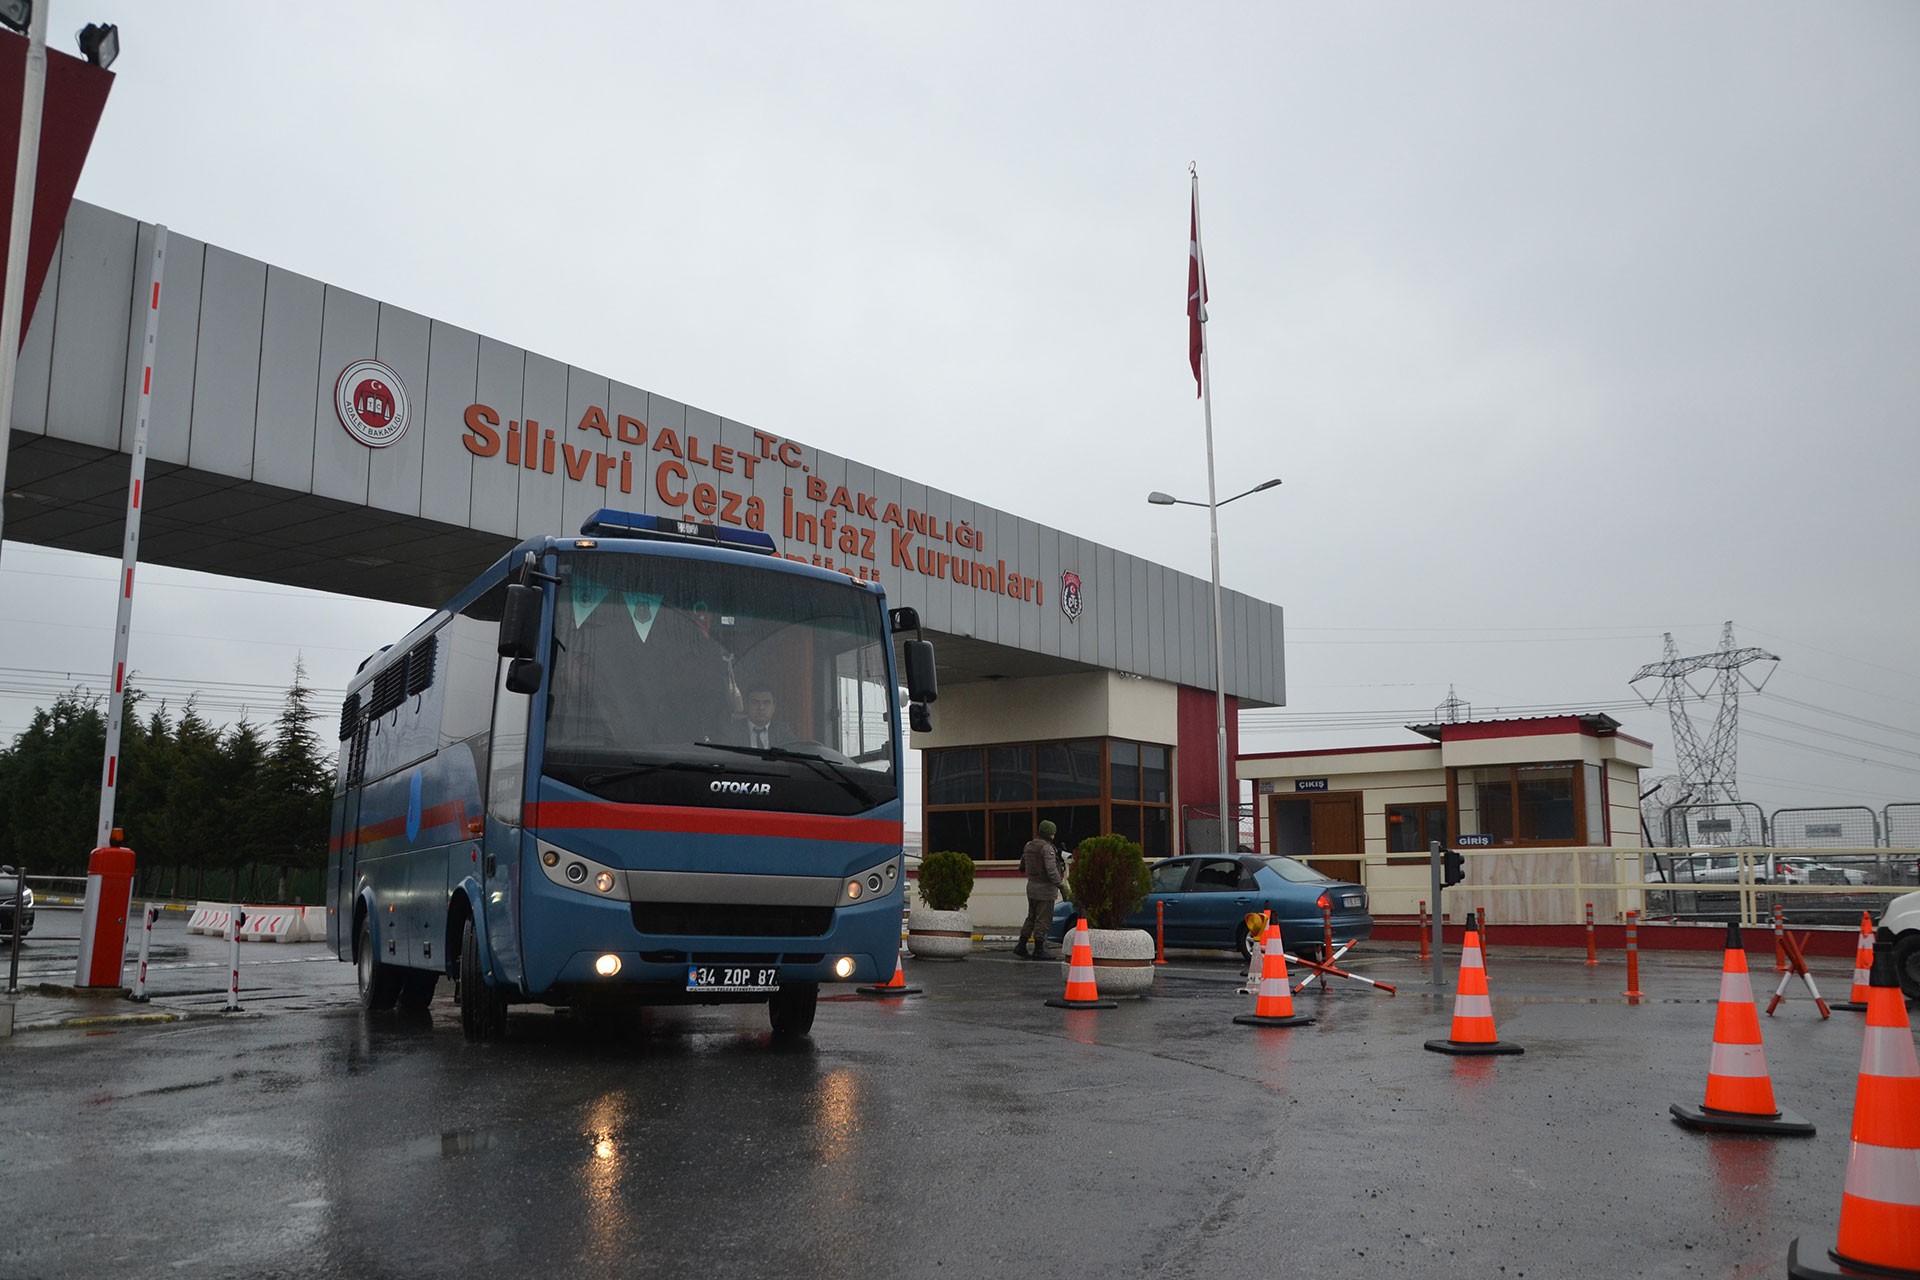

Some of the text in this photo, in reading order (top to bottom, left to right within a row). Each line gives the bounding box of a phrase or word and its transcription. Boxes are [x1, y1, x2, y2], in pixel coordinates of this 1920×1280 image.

[346, 401, 367, 431] ADALET
[754, 431, 810, 472] T.C.
[578, 405, 983, 552] ADALET BAKANLIĞI
[463, 404, 633, 494] Silivri
[656, 460, 765, 531] Ceza
[783, 486, 876, 560] İnfaz
[891, 527, 1043, 606] Kurumları
[710, 781, 771, 795] OTOKAR
[1299, 781, 1324, 789] ÇIKIŞ
[1459, 836, 1489, 845] GİRİŞ
[698, 968, 776, 985] 34 ZOP 87
